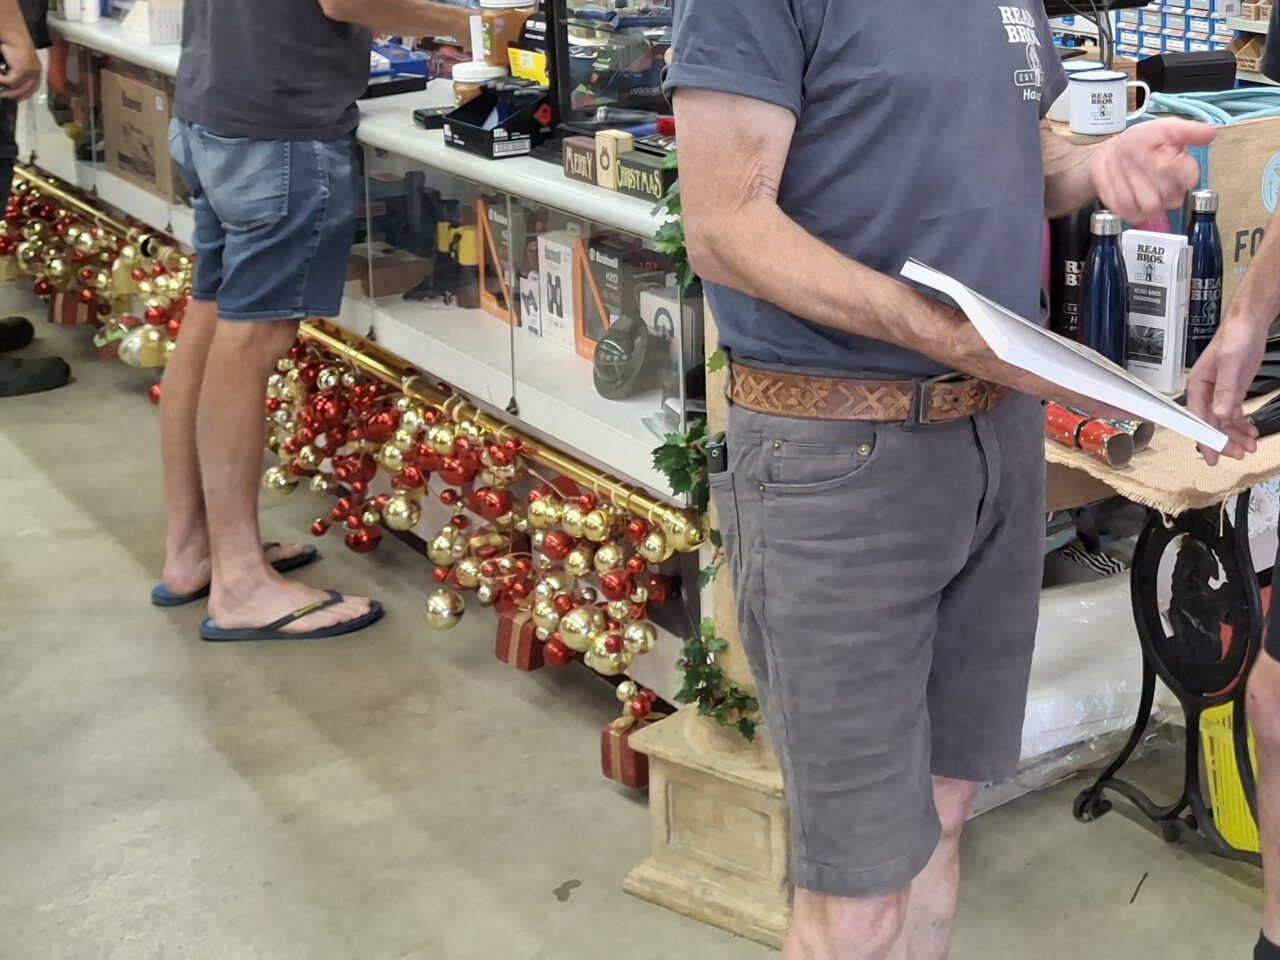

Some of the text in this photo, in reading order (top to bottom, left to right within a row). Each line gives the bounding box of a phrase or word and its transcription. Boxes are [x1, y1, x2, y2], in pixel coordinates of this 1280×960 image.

[998, 6, 1035, 29] READ
[1091, 92, 1114, 100] READ
[565, 146, 593, 180] MERRY
[615, 159, 662, 199] CHRISTMAS
[1137, 244, 1165, 256] READ
[1136, 253, 1165, 265] BROS.
[1192, 277, 1222, 290] REA
[1192, 289, 1221, 301] BRO
